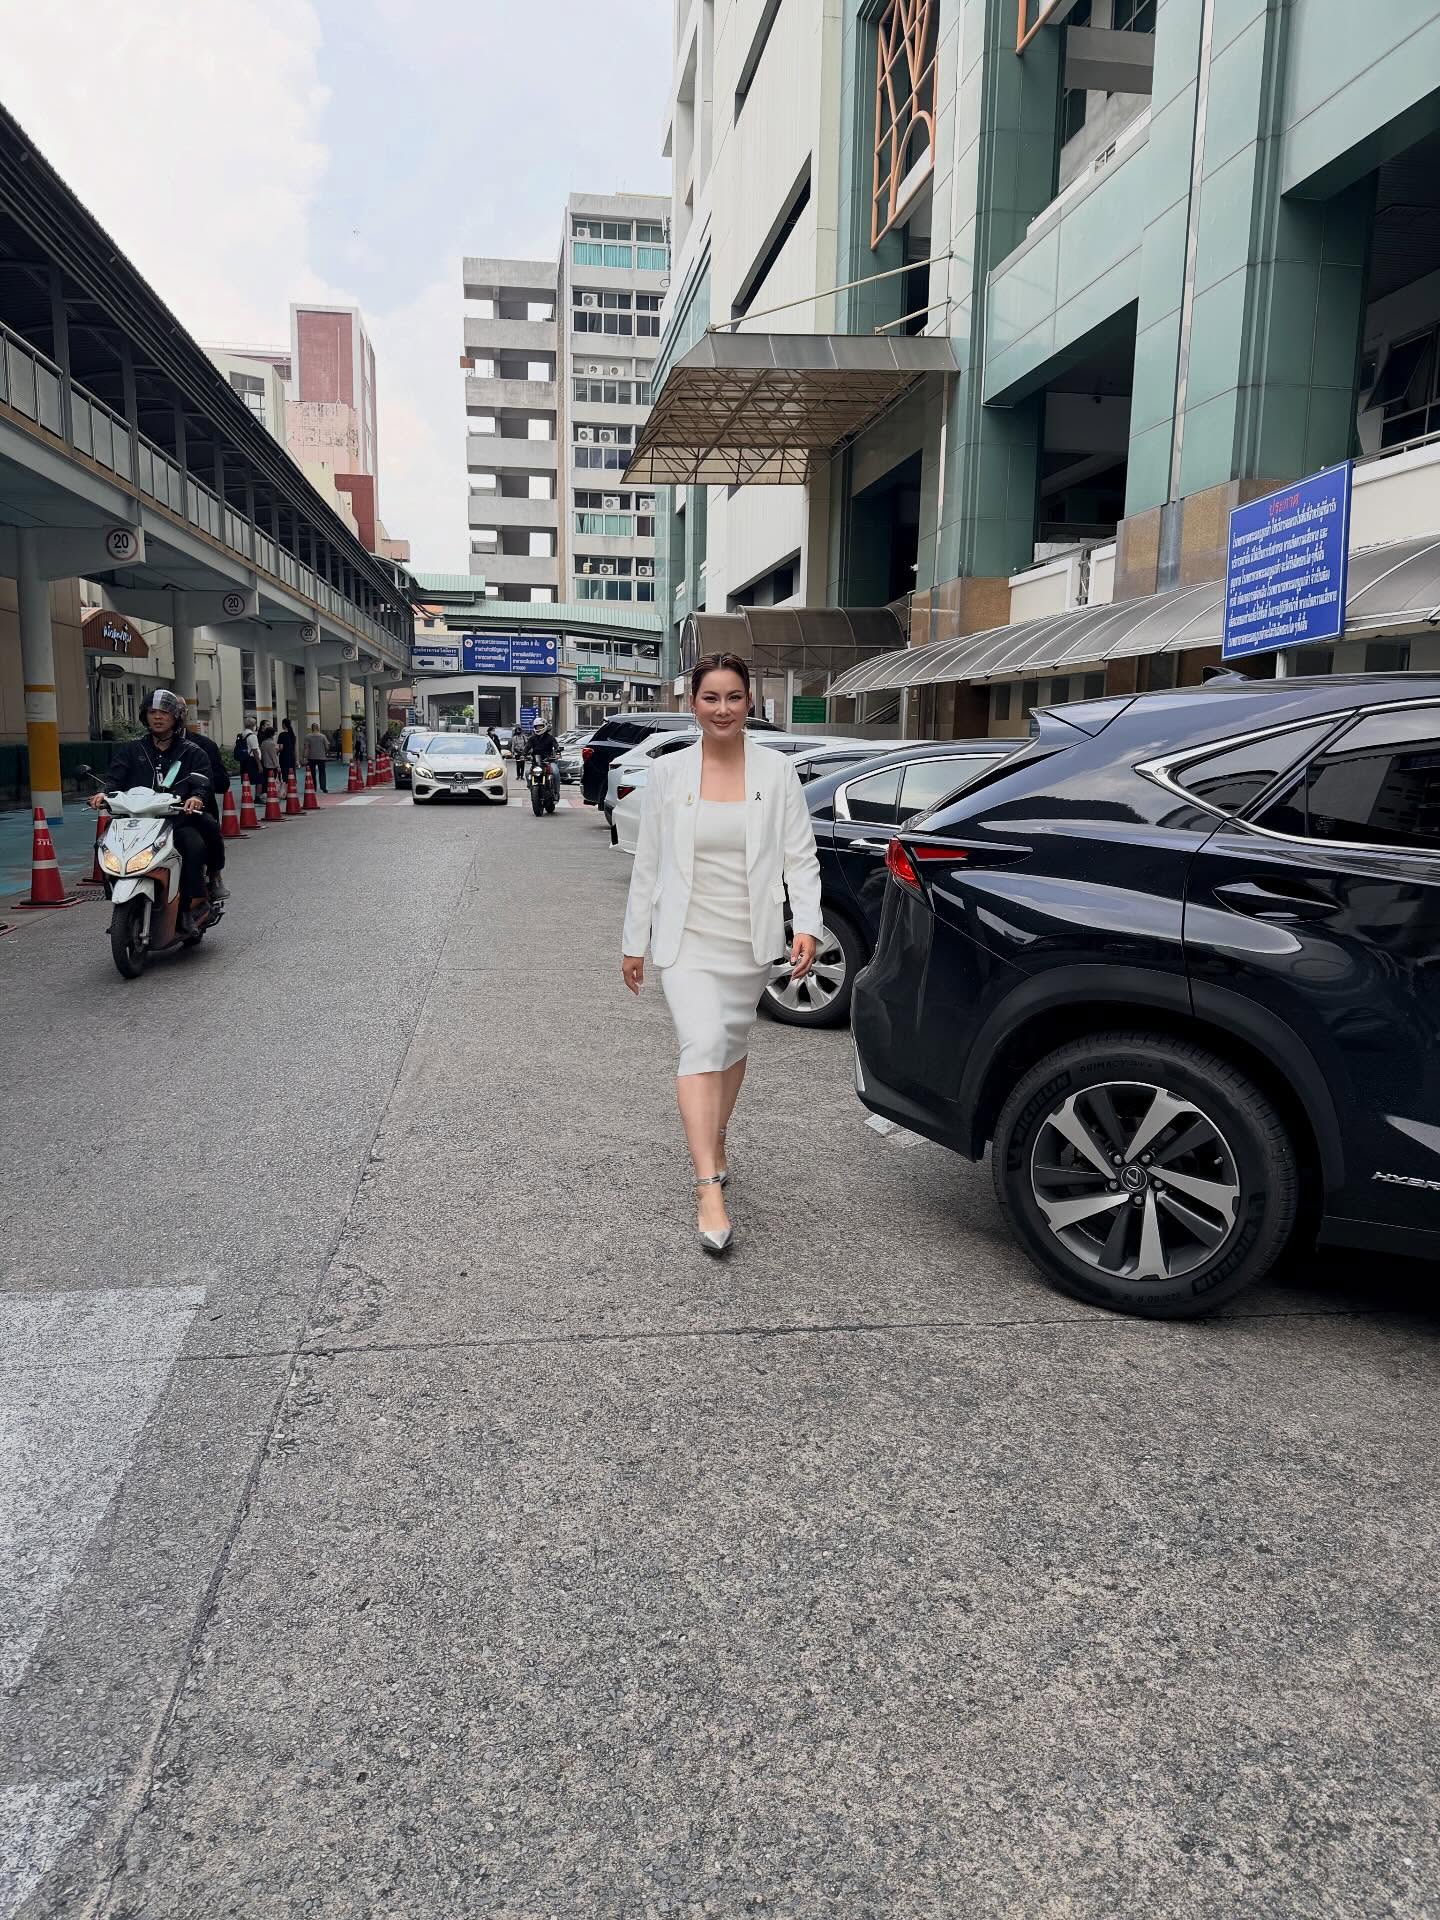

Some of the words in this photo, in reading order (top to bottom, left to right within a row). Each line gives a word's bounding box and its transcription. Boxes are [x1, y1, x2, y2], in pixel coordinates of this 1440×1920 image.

[114, 533, 129, 549] 20
[228, 598, 239, 608] 20
[304, 629, 313, 637] 20
